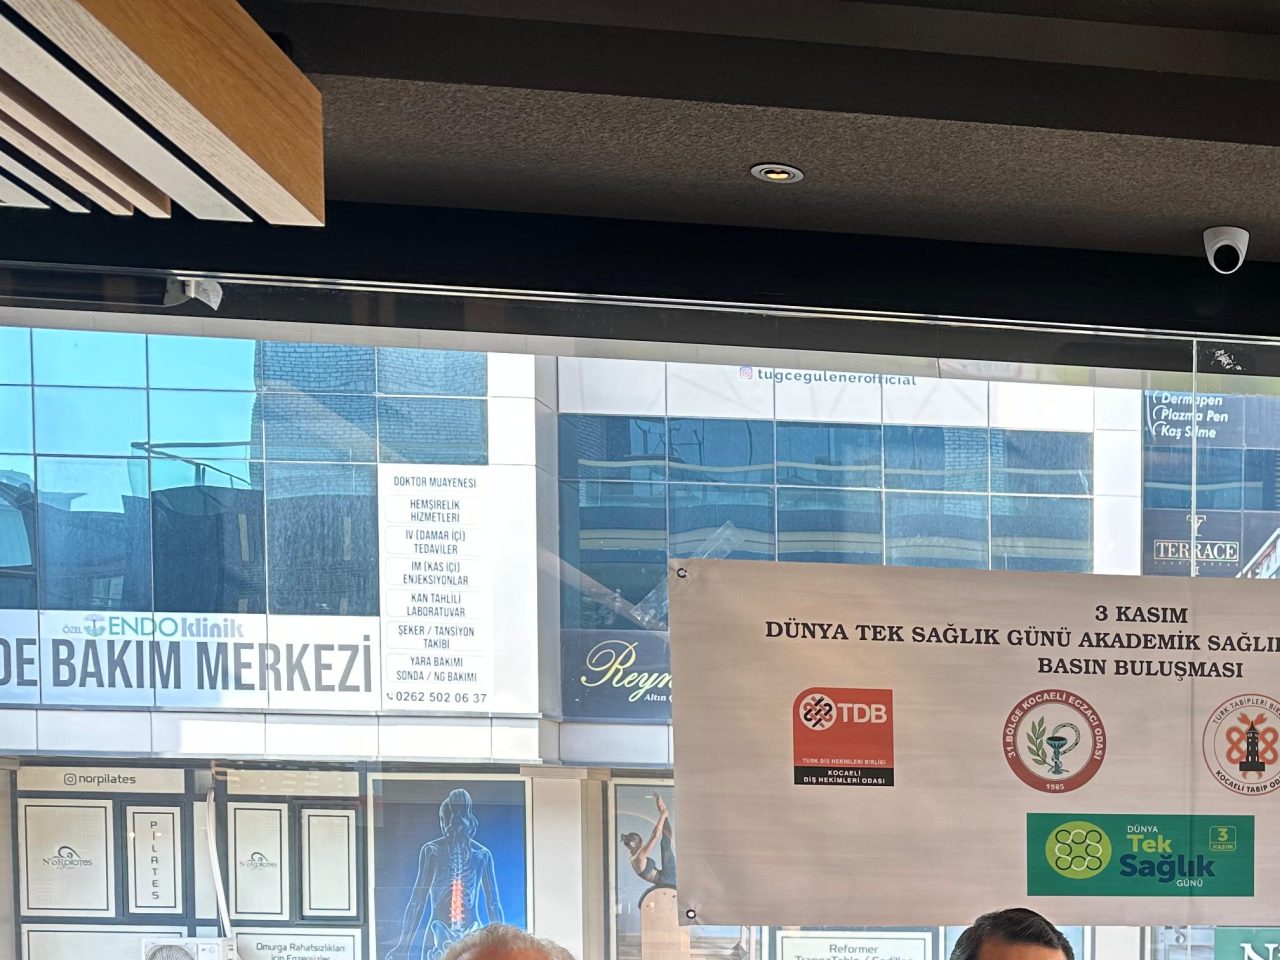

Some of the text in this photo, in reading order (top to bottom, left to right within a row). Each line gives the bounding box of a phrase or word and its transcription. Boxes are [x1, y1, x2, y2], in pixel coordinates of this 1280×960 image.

[1162, 409, 1228, 422] Plazma Pen
[1161, 425, 1216, 439] Kaş Slme
[394, 476, 476, 488] DOKTOR MUAYENESİ
[410, 499, 460, 510] HEMŞİRELİK
[410, 511, 460, 523] HİZMETLERİ
[416, 529, 449, 540] (DAMAR
[452, 529, 466, 541] İÇİ)
[414, 543, 458, 554] TEDAVİLER
[1156, 542, 1237, 559] TERRACE
[424, 562, 443, 572] (KAS
[446, 562, 460, 573] İÇİ)
[412, 593, 428, 603] KAN
[407, 606, 465, 617] LABORATUVAR
[1095, 605, 1188, 624] 3 KASIM
[62, 624, 83, 635] ÖZEL
[398, 625, 424, 636] ŞEKER
[435, 625, 475, 637] TANSİYON
[765, 618, 849, 640] DÜNYA
[856, 624, 904, 642] TEK
[912, 622, 1000, 645] SAĞLIK
[1006, 629, 1072, 648] GÜNÜ
[1078, 630, 1200, 650] AKADEMİK
[52, 639, 181, 689] BAKIM
[197, 635, 372, 692] MERKEZİ
[410, 656, 463, 667] YARA BAKIMI
[1038, 657, 1244, 682] BASIN BULUŞMASI
[397, 671, 424, 680] SONDA
[434, 672, 445, 681] NG
[448, 673, 477, 682] BAKIMI
[396, 692, 487, 703] 0262 502 06 37
[644, 693, 666, 702] Altın
[837, 703, 887, 723] TDB
[1213, 708, 1230, 725] TÜRK
[1230, 697, 1267, 709] TABİPLERİ
[1022, 692, 1066, 710] KOCAELİ
[1068, 696, 1099, 726] ECZACI
[1093, 728, 1104, 760] ODASI
[79, 774, 136, 786] norpilates
[804, 776, 816, 784] DİŞ
[1216, 770, 1244, 792] KOCAELİ
[1247, 785, 1268, 793] TABİP
[1127, 825, 1158, 833] DÜNYA
[1218, 828, 1229, 841] 3
[1127, 834, 1173, 852] Tek
[1120, 854, 1216, 883] Sağlık
[1176, 879, 1203, 887] GÜNÜ
[256, 942, 287, 953] Omurga
[829, 944, 878, 954] Reformer
